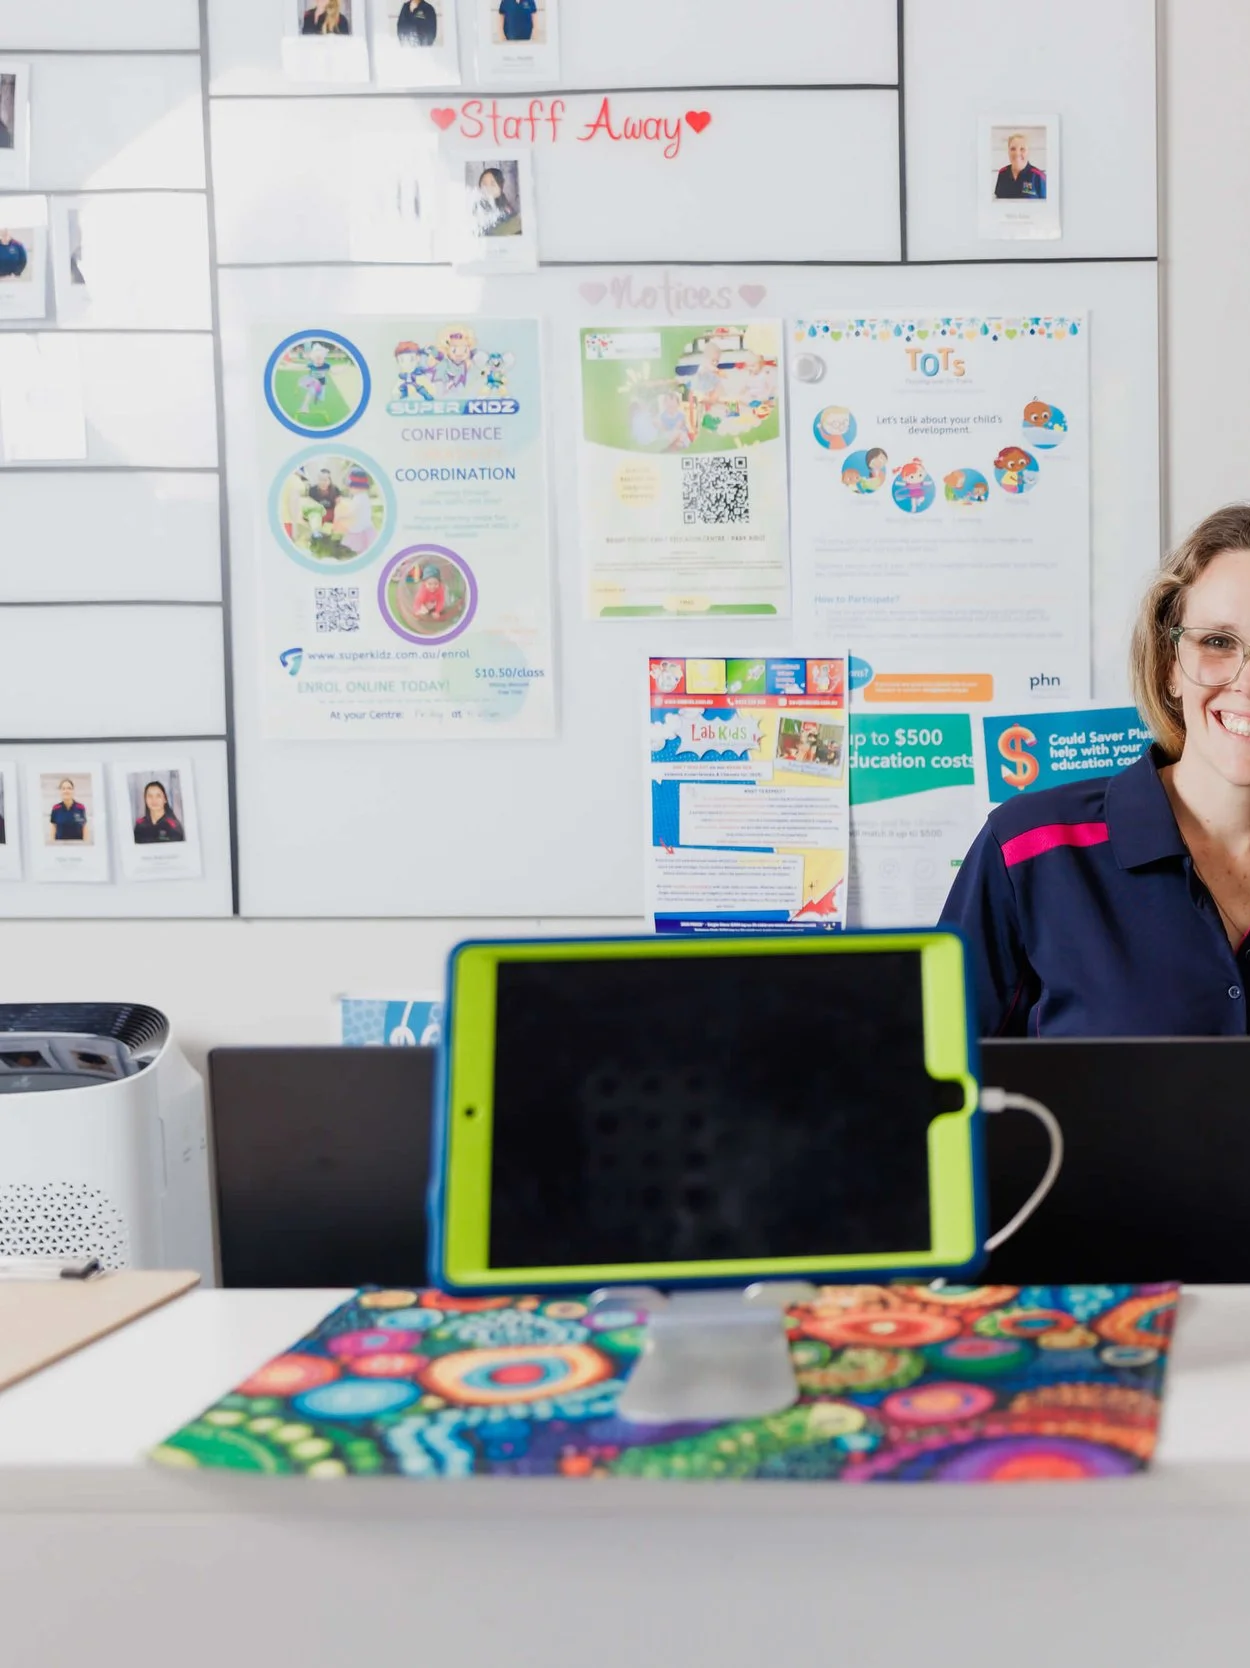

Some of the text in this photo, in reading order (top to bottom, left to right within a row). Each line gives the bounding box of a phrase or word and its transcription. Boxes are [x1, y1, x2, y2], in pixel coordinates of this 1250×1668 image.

[460, 96, 682, 160] Staff Away
[609, 271, 733, 316] Notices
[391, 400, 516, 414] SUPER KIDZ
[876, 414, 1003, 427] Let's talk about your child's
[400, 426, 503, 442] CONFIDENCE
[907, 425, 972, 437] development.
[395, 467, 516, 482] COORDINATION
[475, 667, 545, 679] $10.50/class
[297, 680, 342, 694] ENROL
[345, 680, 395, 693] ONLINE
[1029, 673, 1061, 690] phn
[329, 710, 341, 719] At
[343, 711, 367, 722] your
[450, 711, 463, 720] at
[870, 731, 890, 746] to
[894, 727, 943, 747] $500
[1048, 731, 1086, 746] Could
[1088, 731, 1125, 744] Saver
[1049, 743, 1143, 760] help with your
[849, 750, 975, 769] ducation costs
[1050, 756, 1114, 771] education
